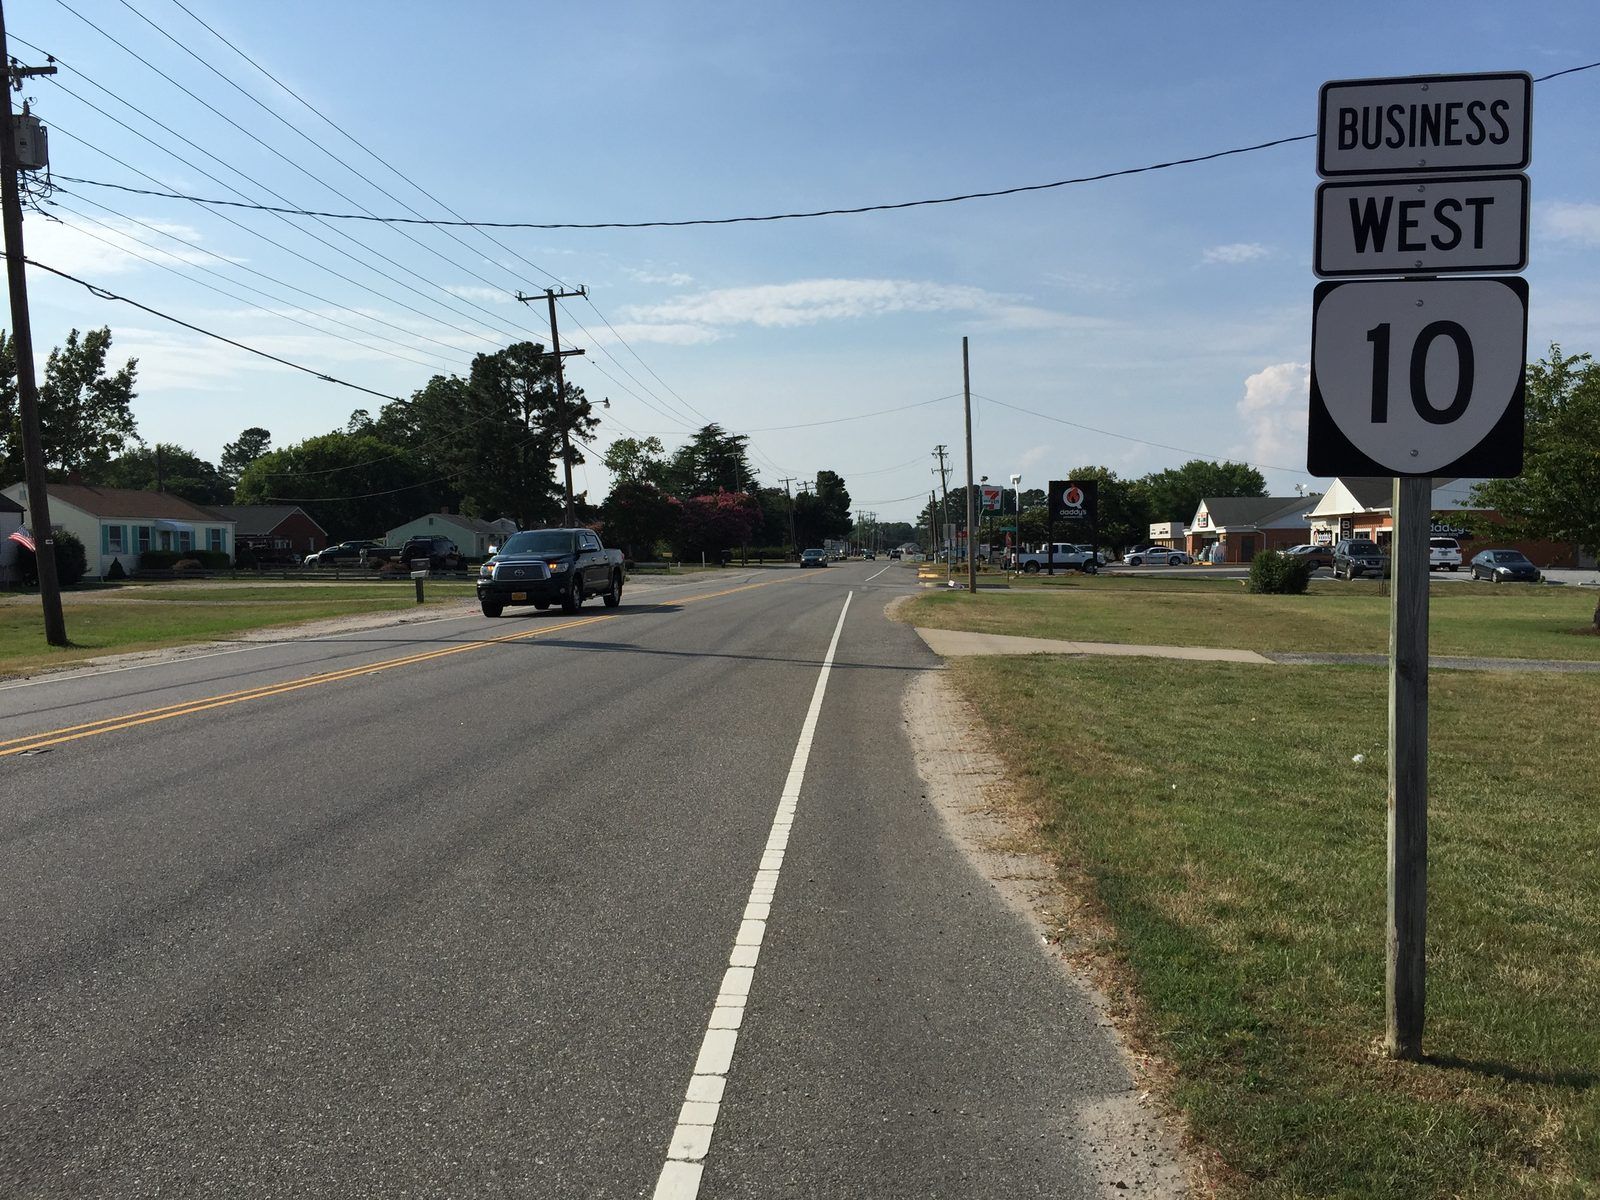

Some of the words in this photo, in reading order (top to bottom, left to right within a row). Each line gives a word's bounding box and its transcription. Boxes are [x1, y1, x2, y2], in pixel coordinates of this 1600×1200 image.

[1338, 99, 1510, 150] BUSINESS
[1349, 196, 1495, 254] WEST
[1367, 320, 1475, 425] 10
